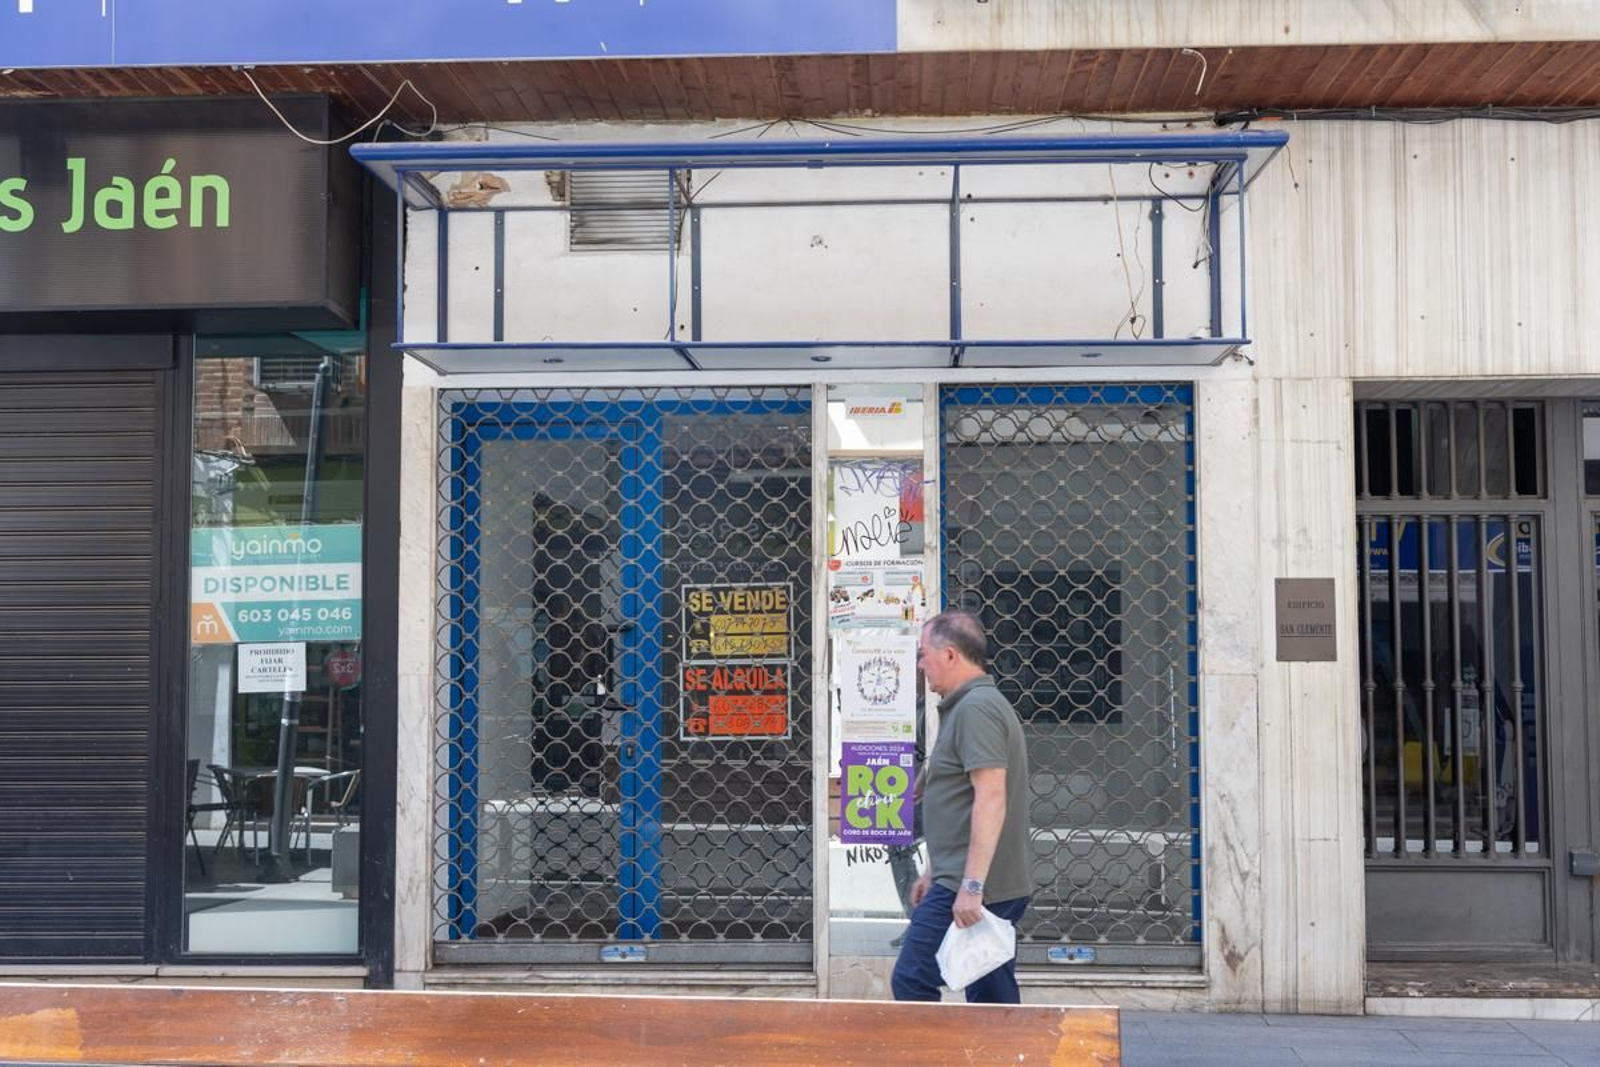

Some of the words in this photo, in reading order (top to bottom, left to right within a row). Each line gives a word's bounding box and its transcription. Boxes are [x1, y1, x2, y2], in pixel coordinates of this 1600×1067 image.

[61, 157, 230, 234] Jaén
[849, 406, 887, 415] IBERIA
[232, 534, 322, 560] yainmo
[204, 573, 350, 594] DISPONIBLE
[689, 591, 713, 612] SE
[720, 590, 787, 612] VENDE
[1287, 601, 1325, 609] EDIFICIO
[238, 608, 272, 623] 603
[278, 607, 312, 622] 045
[318, 606, 352, 621] 046
[278, 624, 353, 637] yainmo.com
[1280, 623, 1295, 634] SAN
[1297, 623, 1333, 634] CLEMENTE
[249, 648, 295, 656] PROHIBIDO
[260, 657, 283, 665] FIJAR
[685, 668, 707, 691] SE
[712, 667, 786, 691] ALQUILA
[865, 755, 890, 766] JAÉN
[847, 765, 909, 798] RO
[845, 796, 905, 829] CK
[897, 828, 912, 836] JAÉN
